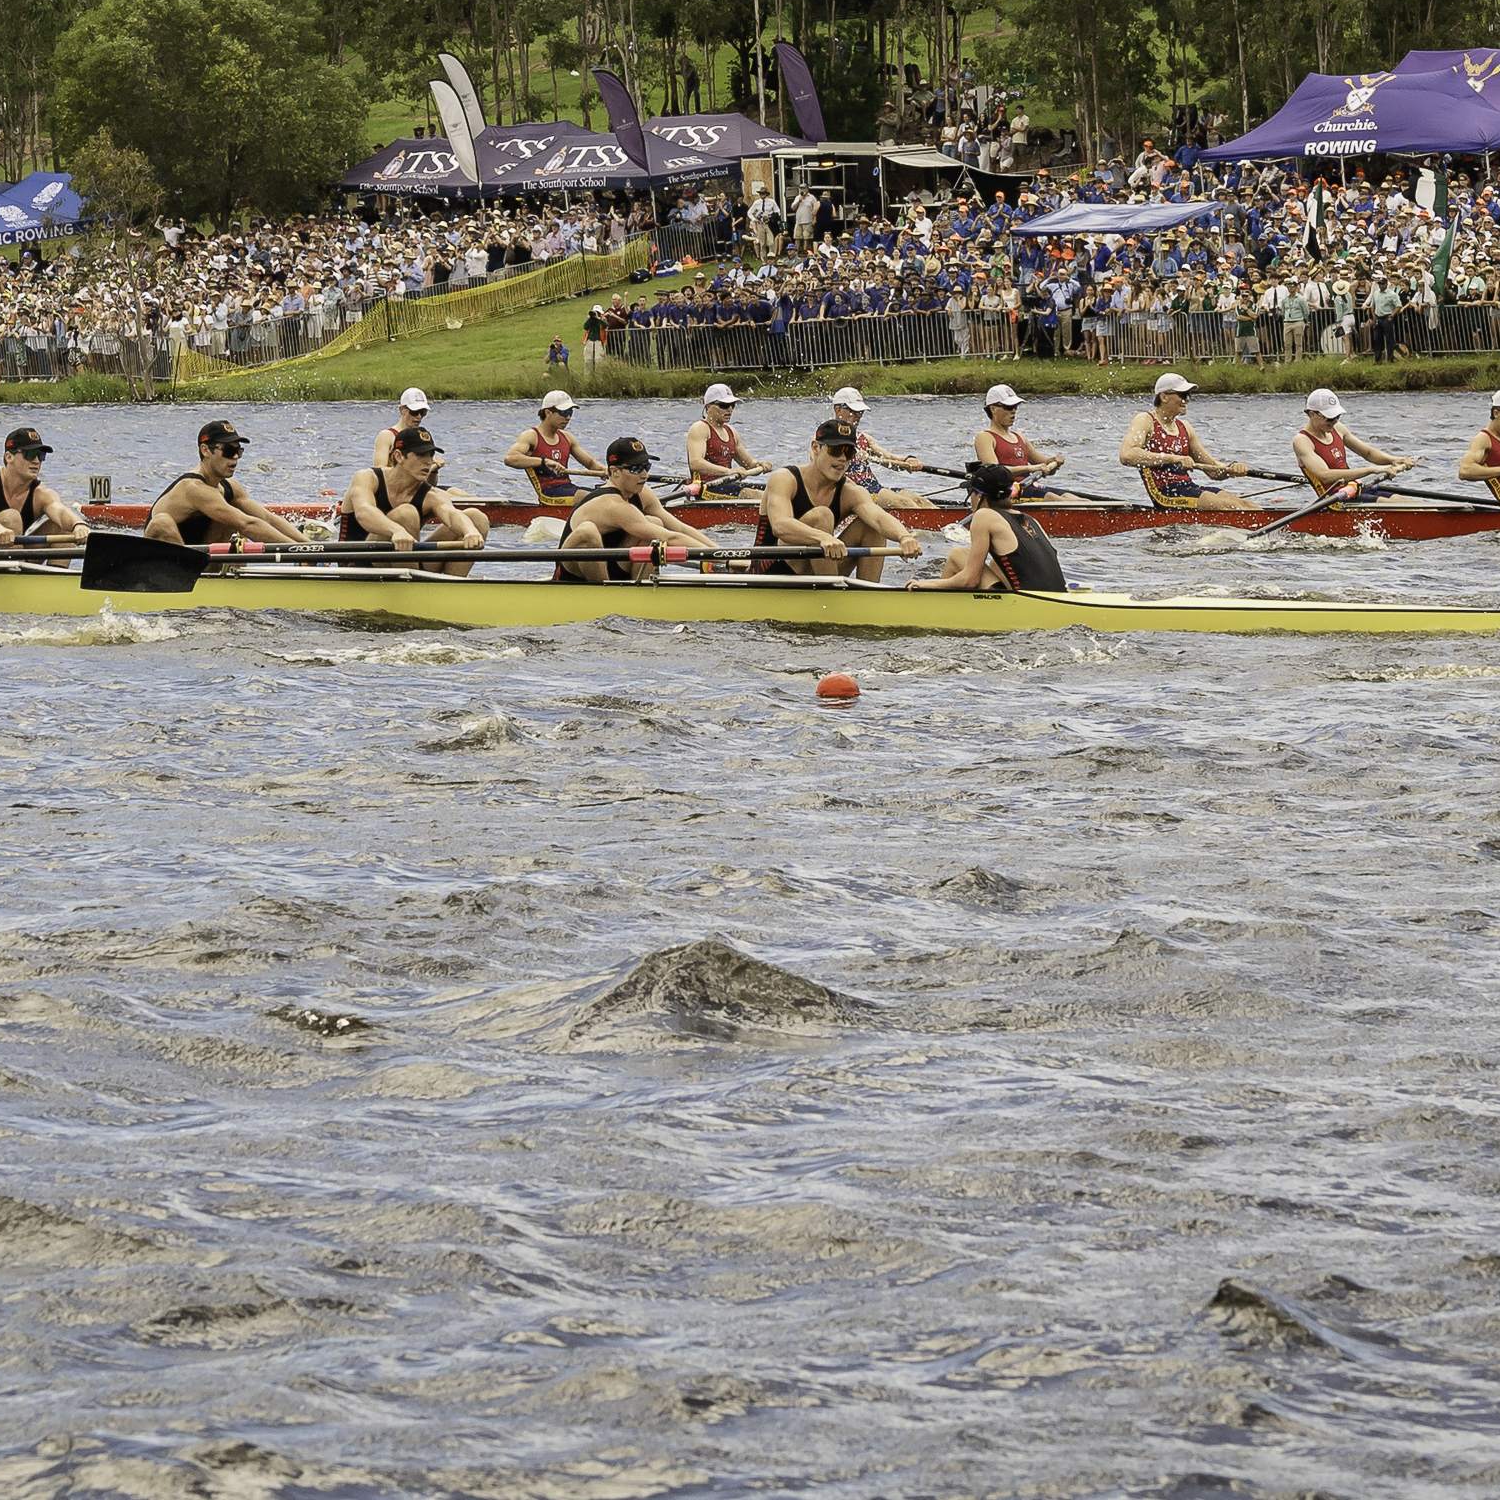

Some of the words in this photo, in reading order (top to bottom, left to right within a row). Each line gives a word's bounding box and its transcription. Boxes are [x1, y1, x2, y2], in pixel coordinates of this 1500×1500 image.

[1313, 118, 1378, 133] Churchie.
[659, 126, 728, 147] TSS
[761, 138, 794, 147] TSS
[1304, 139, 1377, 155] ROWING
[404, 151, 460, 174] TSS
[566, 145, 629, 168] TSS
[669, 155, 704, 166] TSS
[522, 180, 537, 190] The
[538, 177, 578, 191] Southport
[579, 175, 607, 188] School
[667, 175, 680, 184] The
[710, 167, 729, 178] School
[412, 184, 439, 195] School
[15, 223, 74, 243] ROWING
[90, 478, 110, 499] V10
